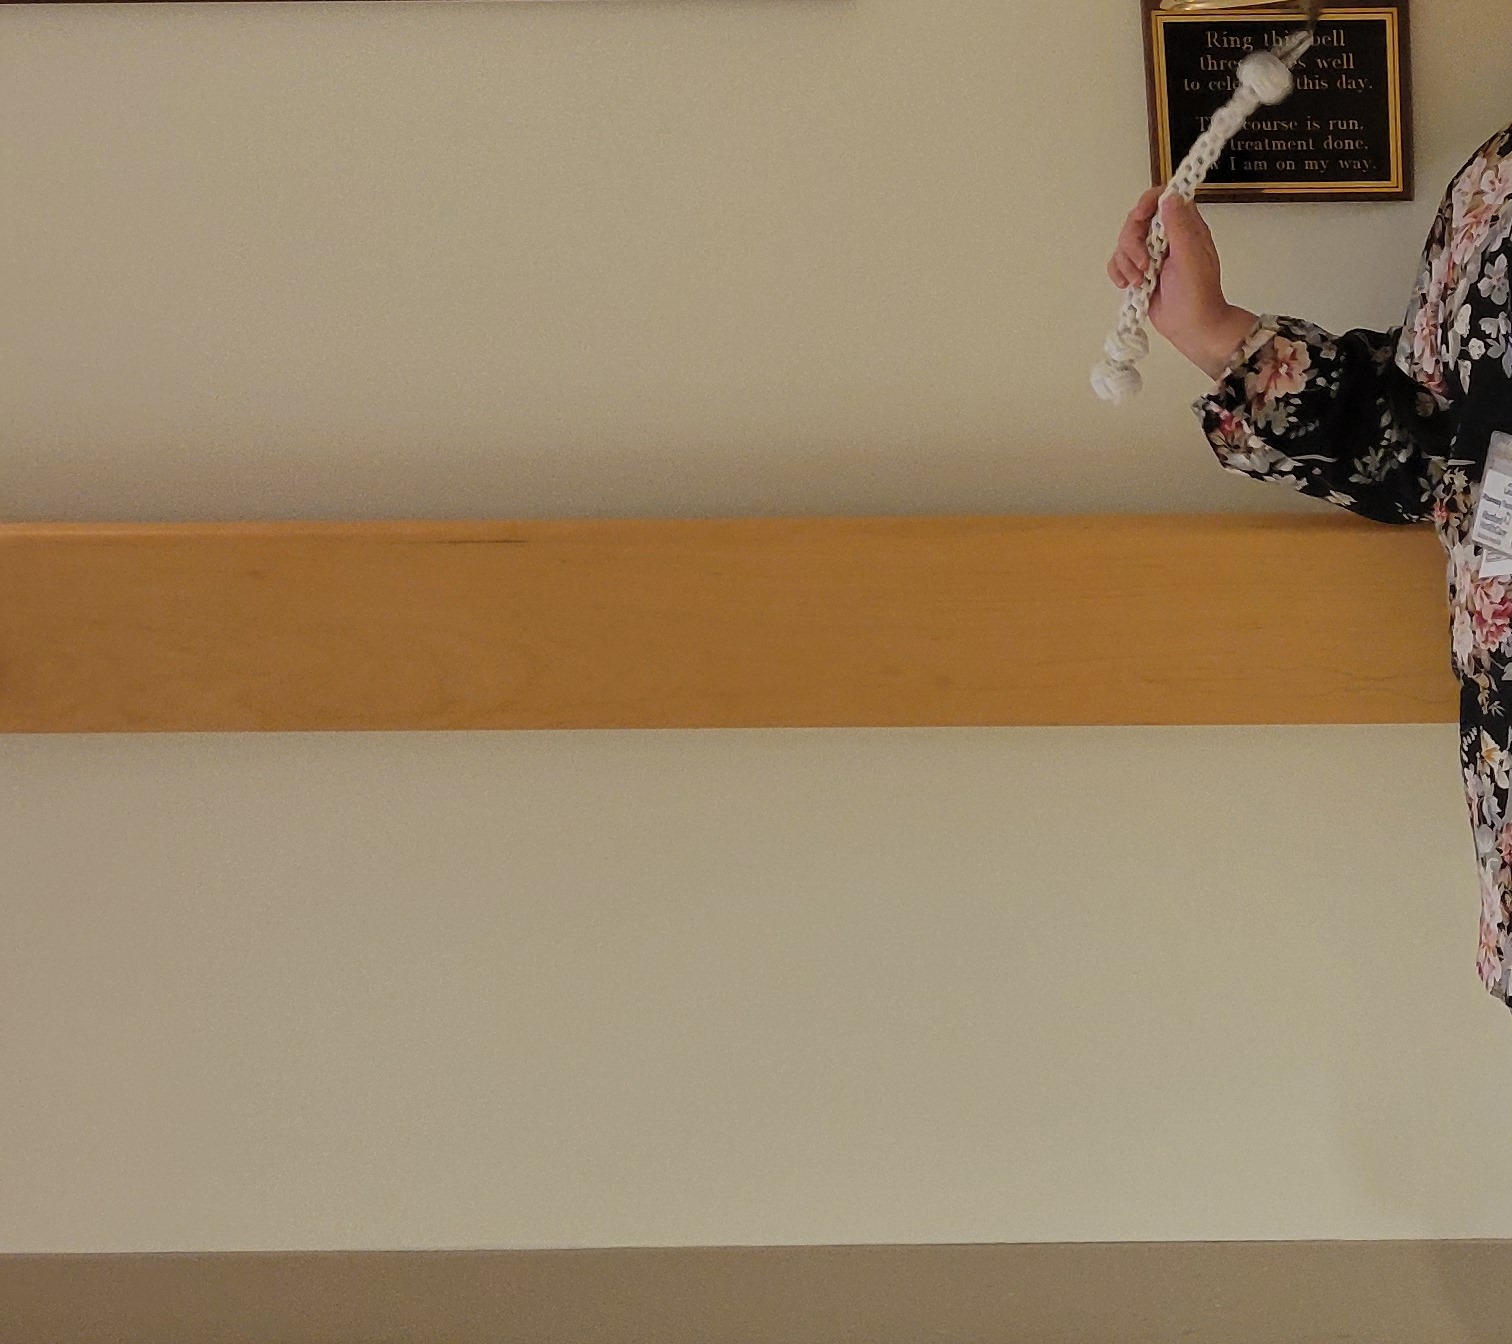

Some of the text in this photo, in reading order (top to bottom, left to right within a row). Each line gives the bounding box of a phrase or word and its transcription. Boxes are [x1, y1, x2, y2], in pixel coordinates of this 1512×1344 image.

[1206, 30, 1254, 51] Ring
[1200, 54, 1240, 71] thre
[1317, 52, 1355, 69] well
[1184, 78, 1200, 91] to
[1296, 74, 1329, 90] this
[1336, 74, 1373, 93] day.
[1243, 119, 1298, 131] course
[1306, 115, 1321, 131] is
[1230, 135, 1369, 151] treatment done.
[1229, 156, 1236, 171] I
[1243, 159, 1268, 171] am
[1276, 159, 1296, 171] on
[1304, 159, 1329, 173] my
